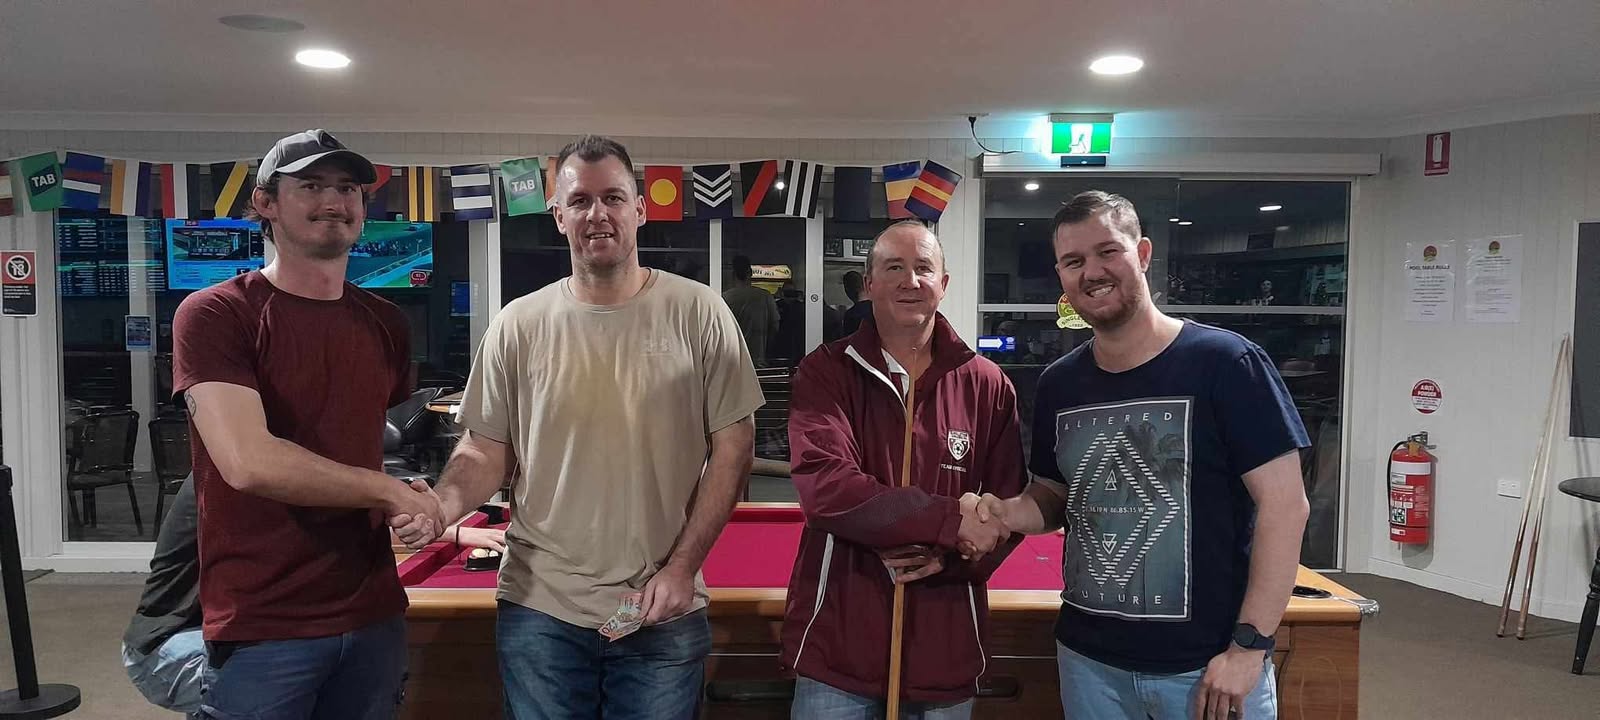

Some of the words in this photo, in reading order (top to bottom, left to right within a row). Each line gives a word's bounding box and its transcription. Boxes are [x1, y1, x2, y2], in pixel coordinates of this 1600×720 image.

[31, 173, 56, 188] TAB
[511, 179, 536, 192] TAB
[1063, 412, 1173, 431] ALTERED
[1081, 589, 1162, 606] UTURE
